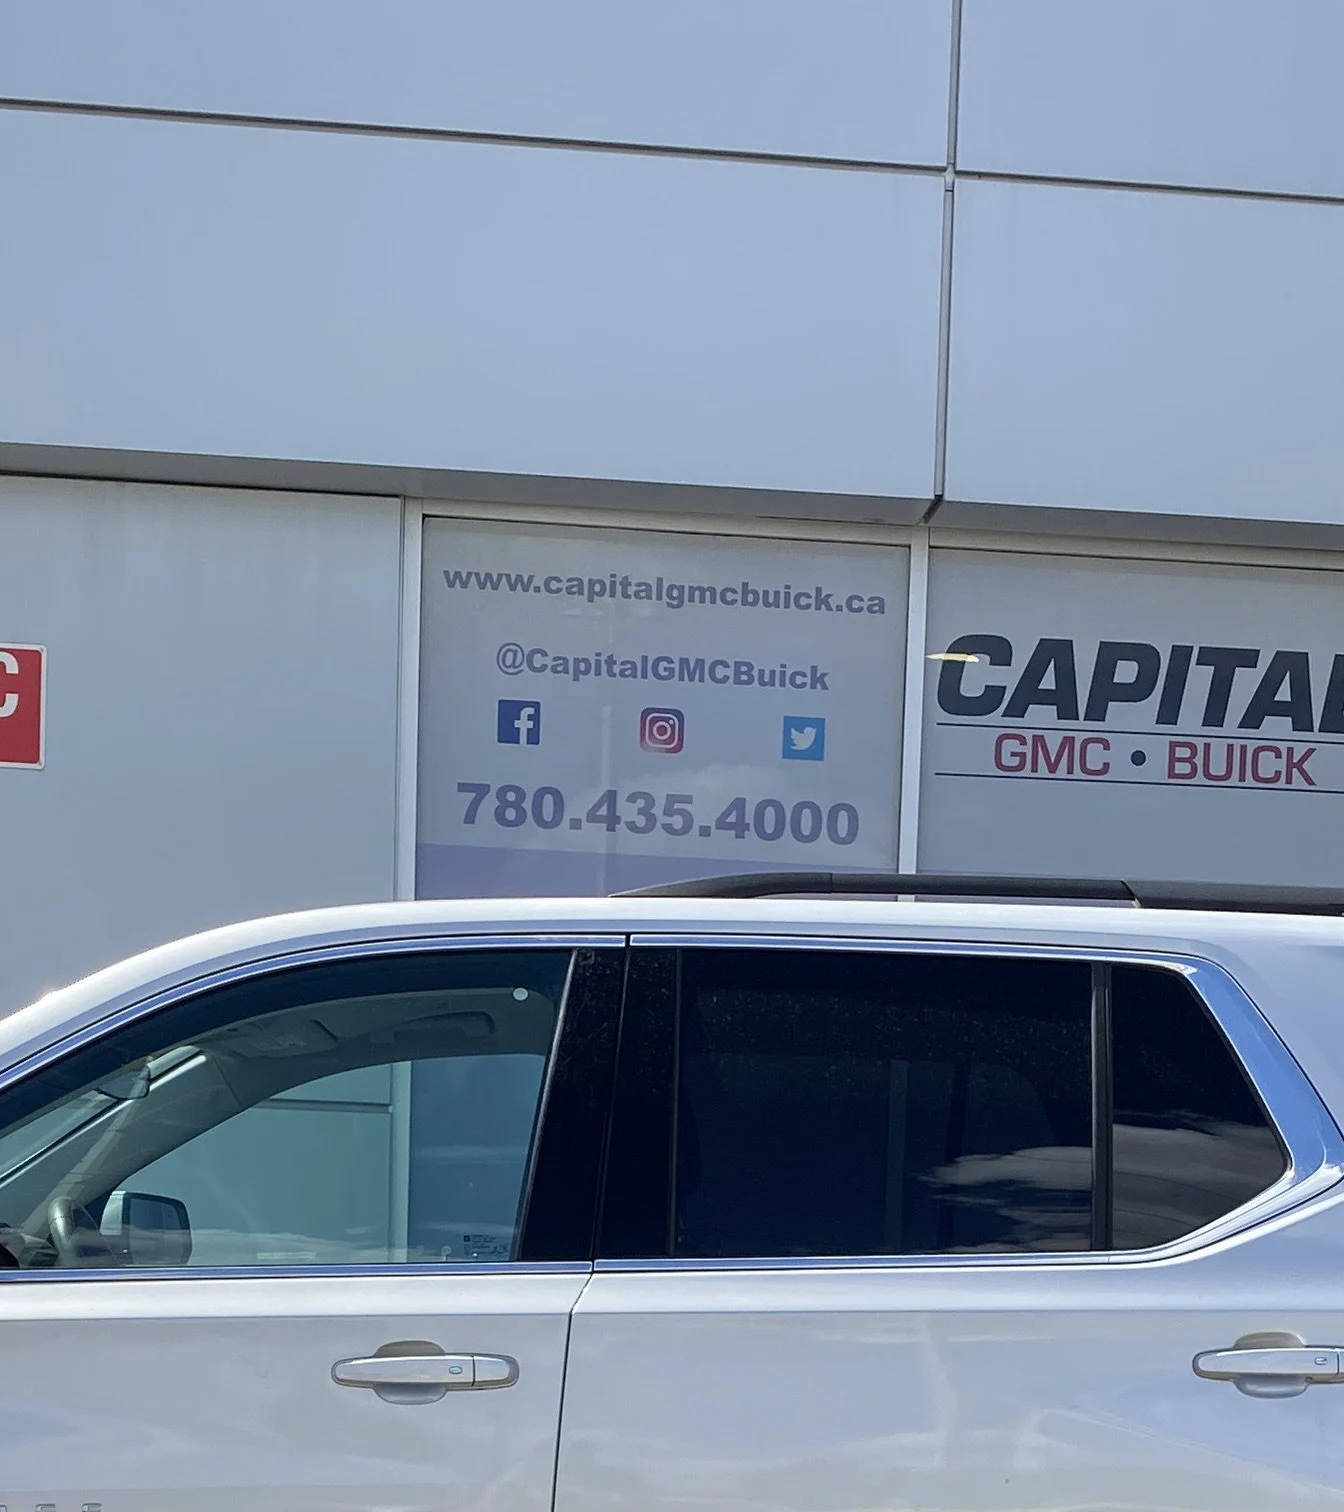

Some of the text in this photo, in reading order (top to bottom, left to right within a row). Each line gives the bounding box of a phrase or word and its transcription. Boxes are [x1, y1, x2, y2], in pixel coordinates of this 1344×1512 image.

[442, 569, 886, 616] www.capitalgmcbuick.ca
[495, 642, 830, 691] @CapitalGMCBuick
[993, 733, 1318, 787] GMC BUICK
[456, 782, 860, 847] 780.435.4000
